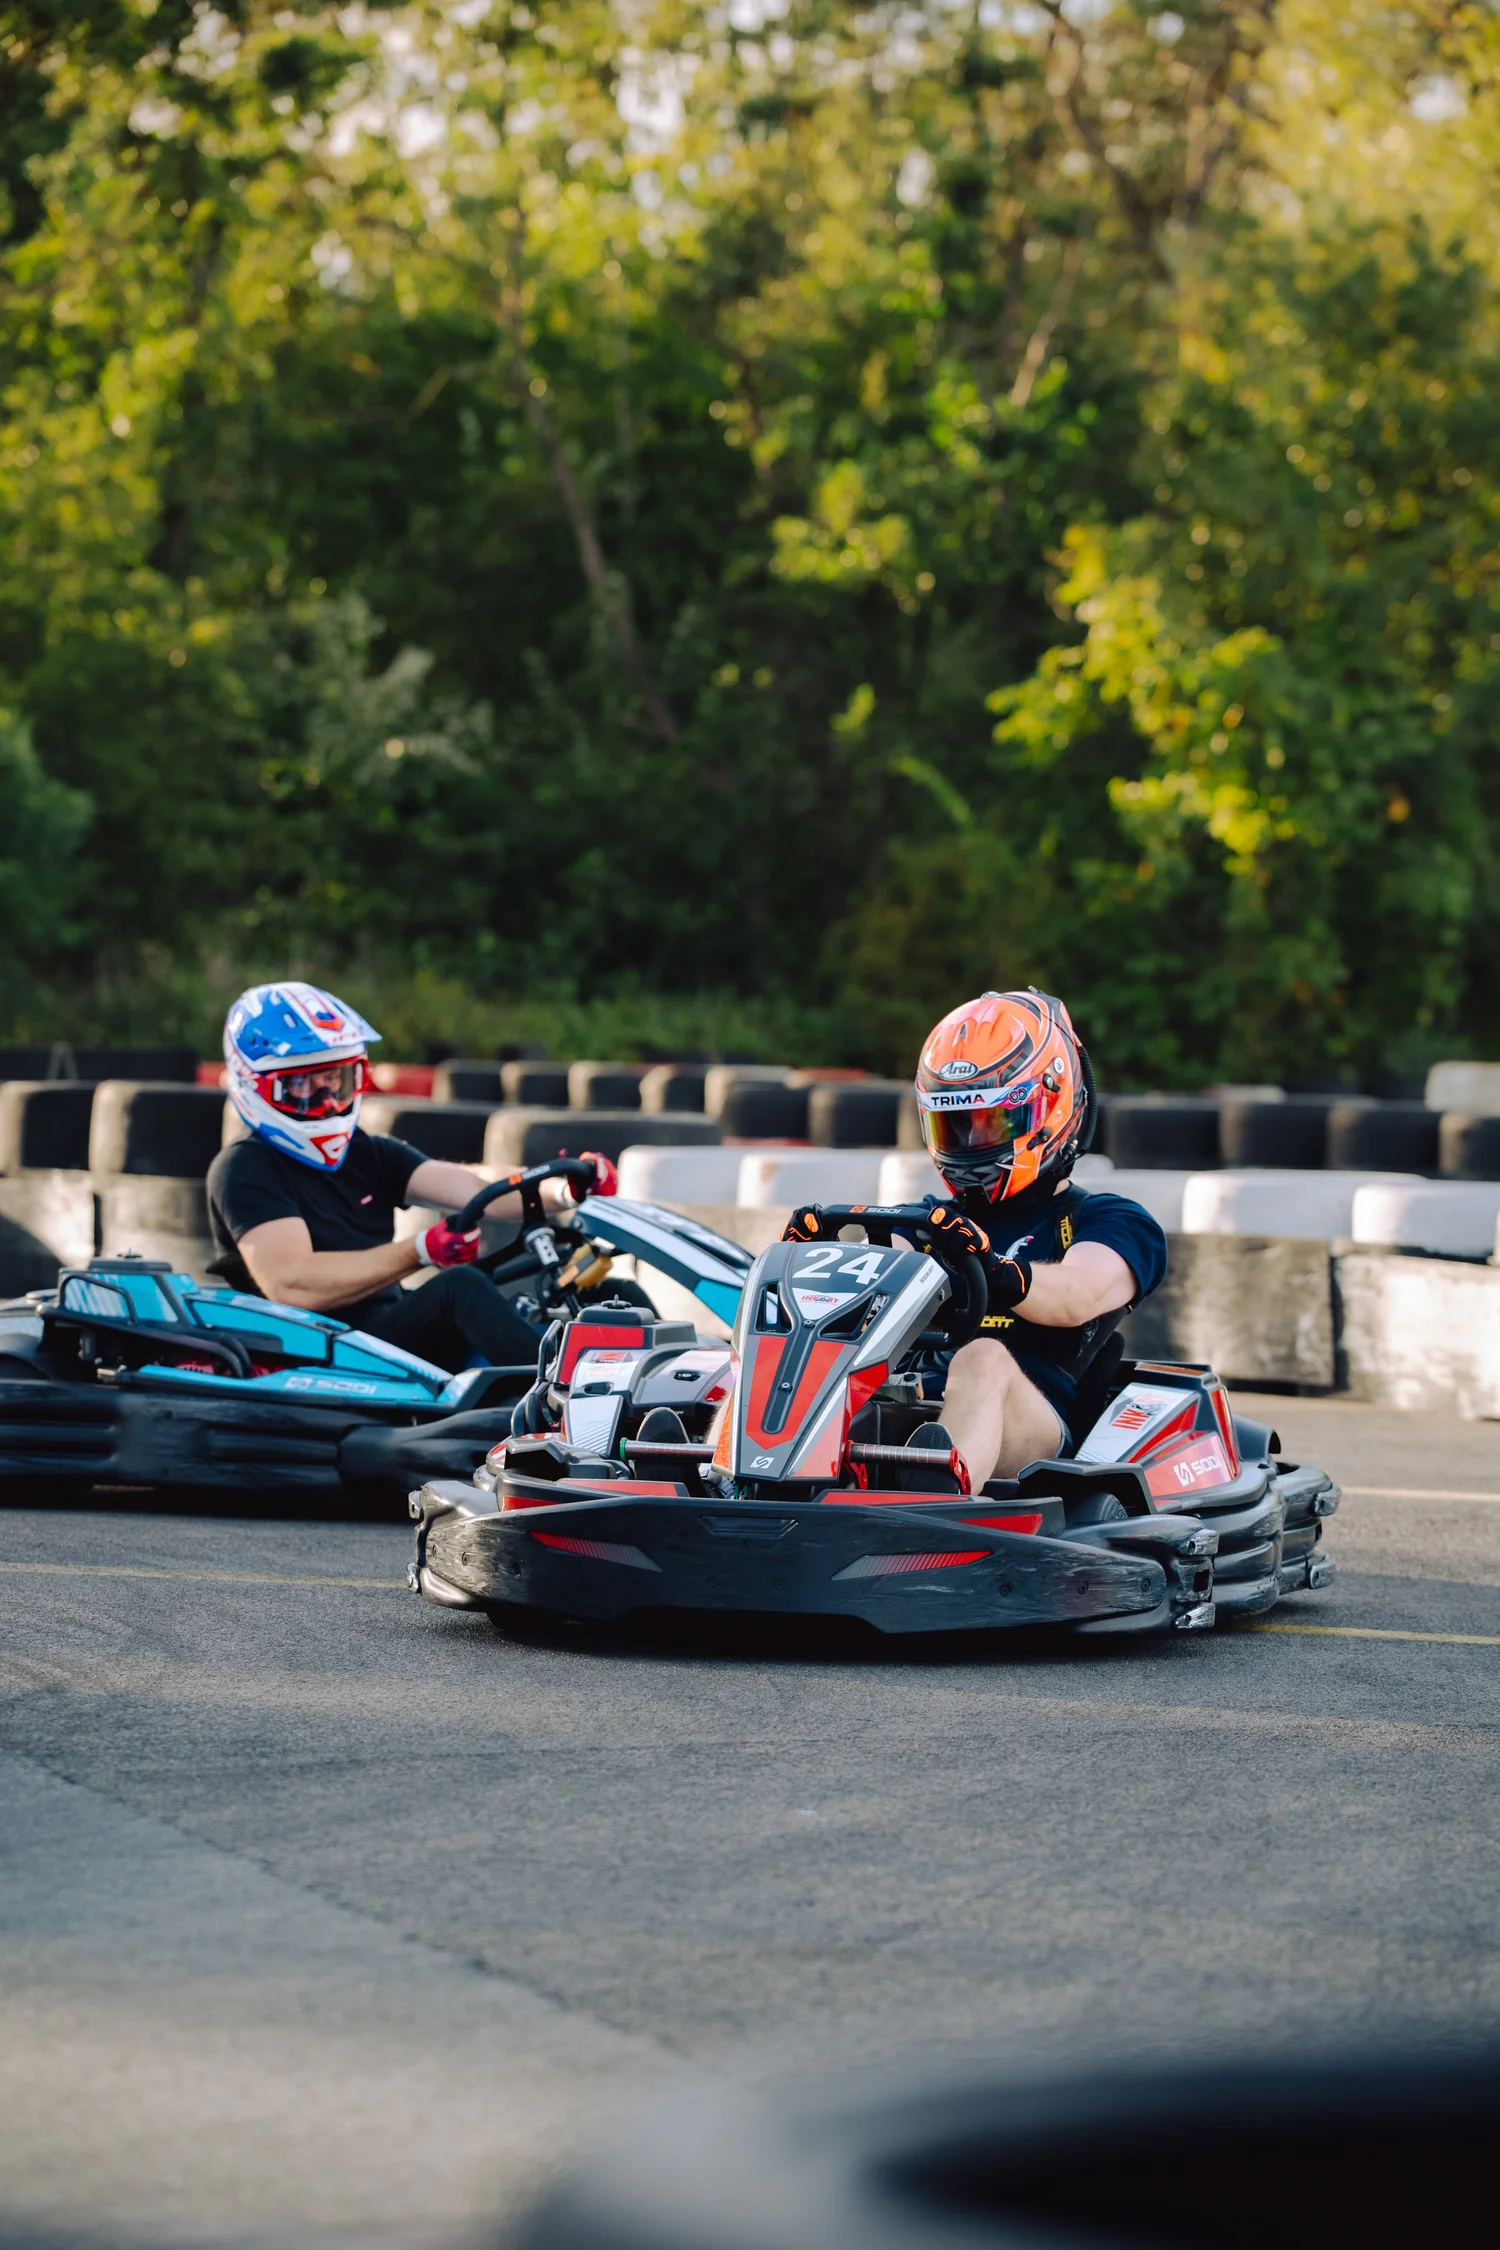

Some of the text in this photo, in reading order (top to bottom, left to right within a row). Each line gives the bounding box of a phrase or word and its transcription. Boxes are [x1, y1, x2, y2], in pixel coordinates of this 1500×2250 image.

[943, 1062, 974, 1075] Arai
[931, 1094, 985, 1106] TRIMA
[792, 1247, 885, 1285] 24
